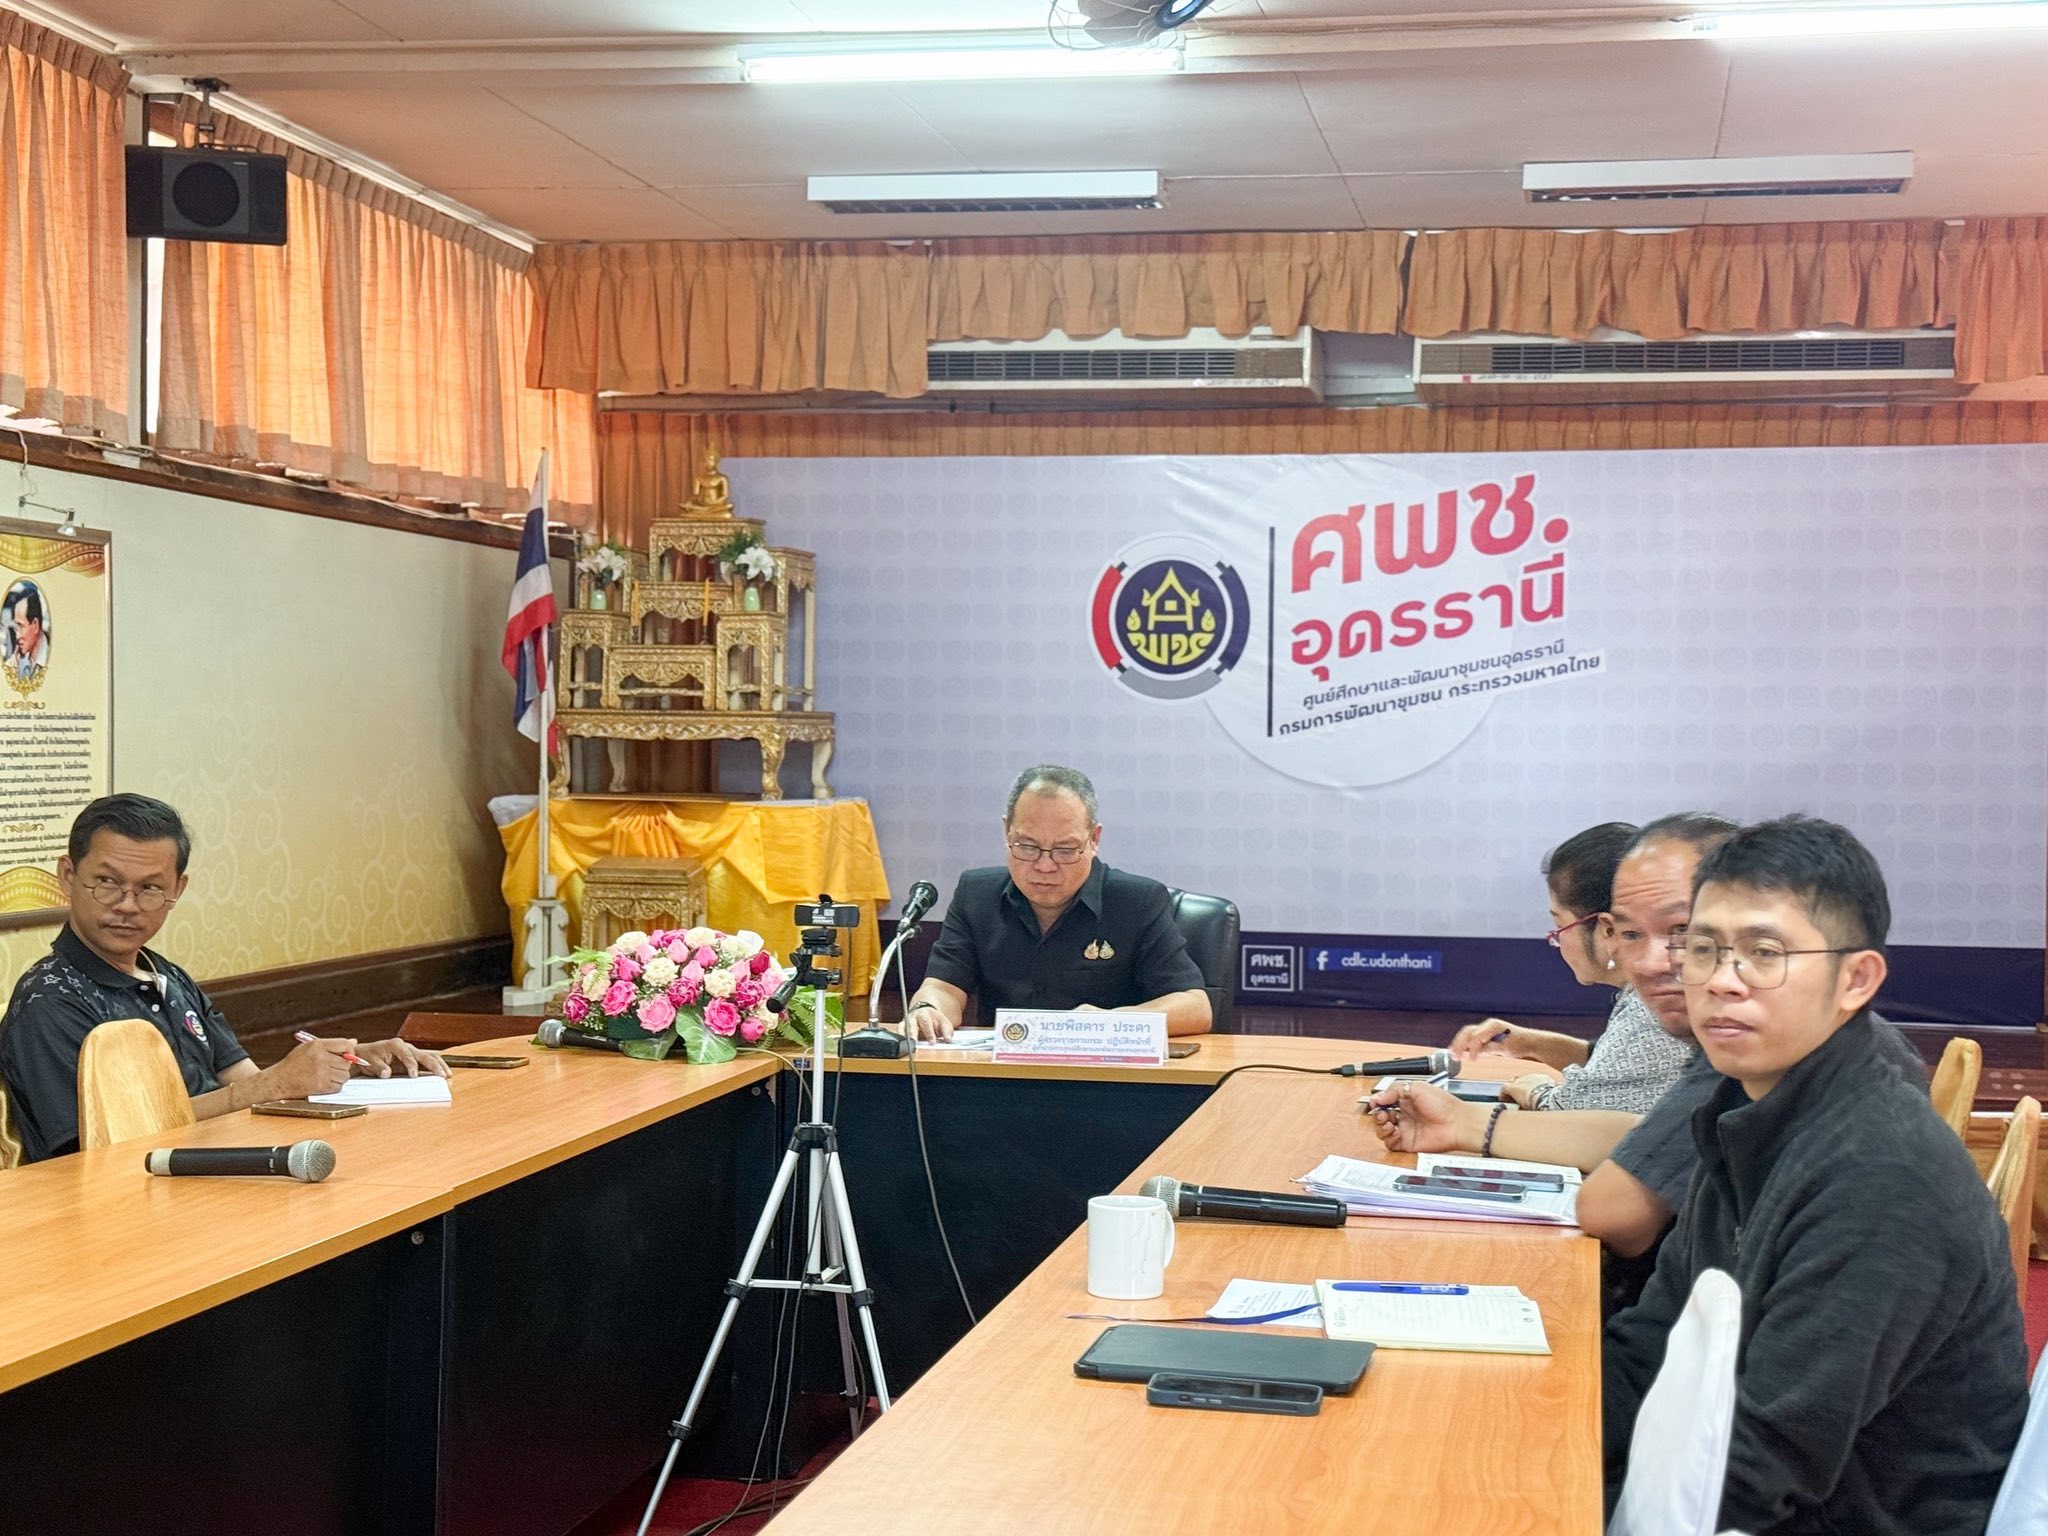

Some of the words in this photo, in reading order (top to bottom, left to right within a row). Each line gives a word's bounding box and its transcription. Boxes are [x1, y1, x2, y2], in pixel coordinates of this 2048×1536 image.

[1292, 474, 1569, 593] ศพช.
[1292, 552, 1565, 682] อุดรธานี
[1279, 689, 1443, 735] กรมการพัฒนาชุมชน
[1449, 654, 1600, 699] กระทรวงมหาดไทย
[1303, 638, 1565, 710] ศูนย์ศึกษาและพัฒนาชุมชนอุดรธานี
[1250, 953, 1289, 968] ศพช.
[1250, 972, 1289, 986] อุดรธานี
[1341, 952, 1432, 969] cdlc.udonthani
